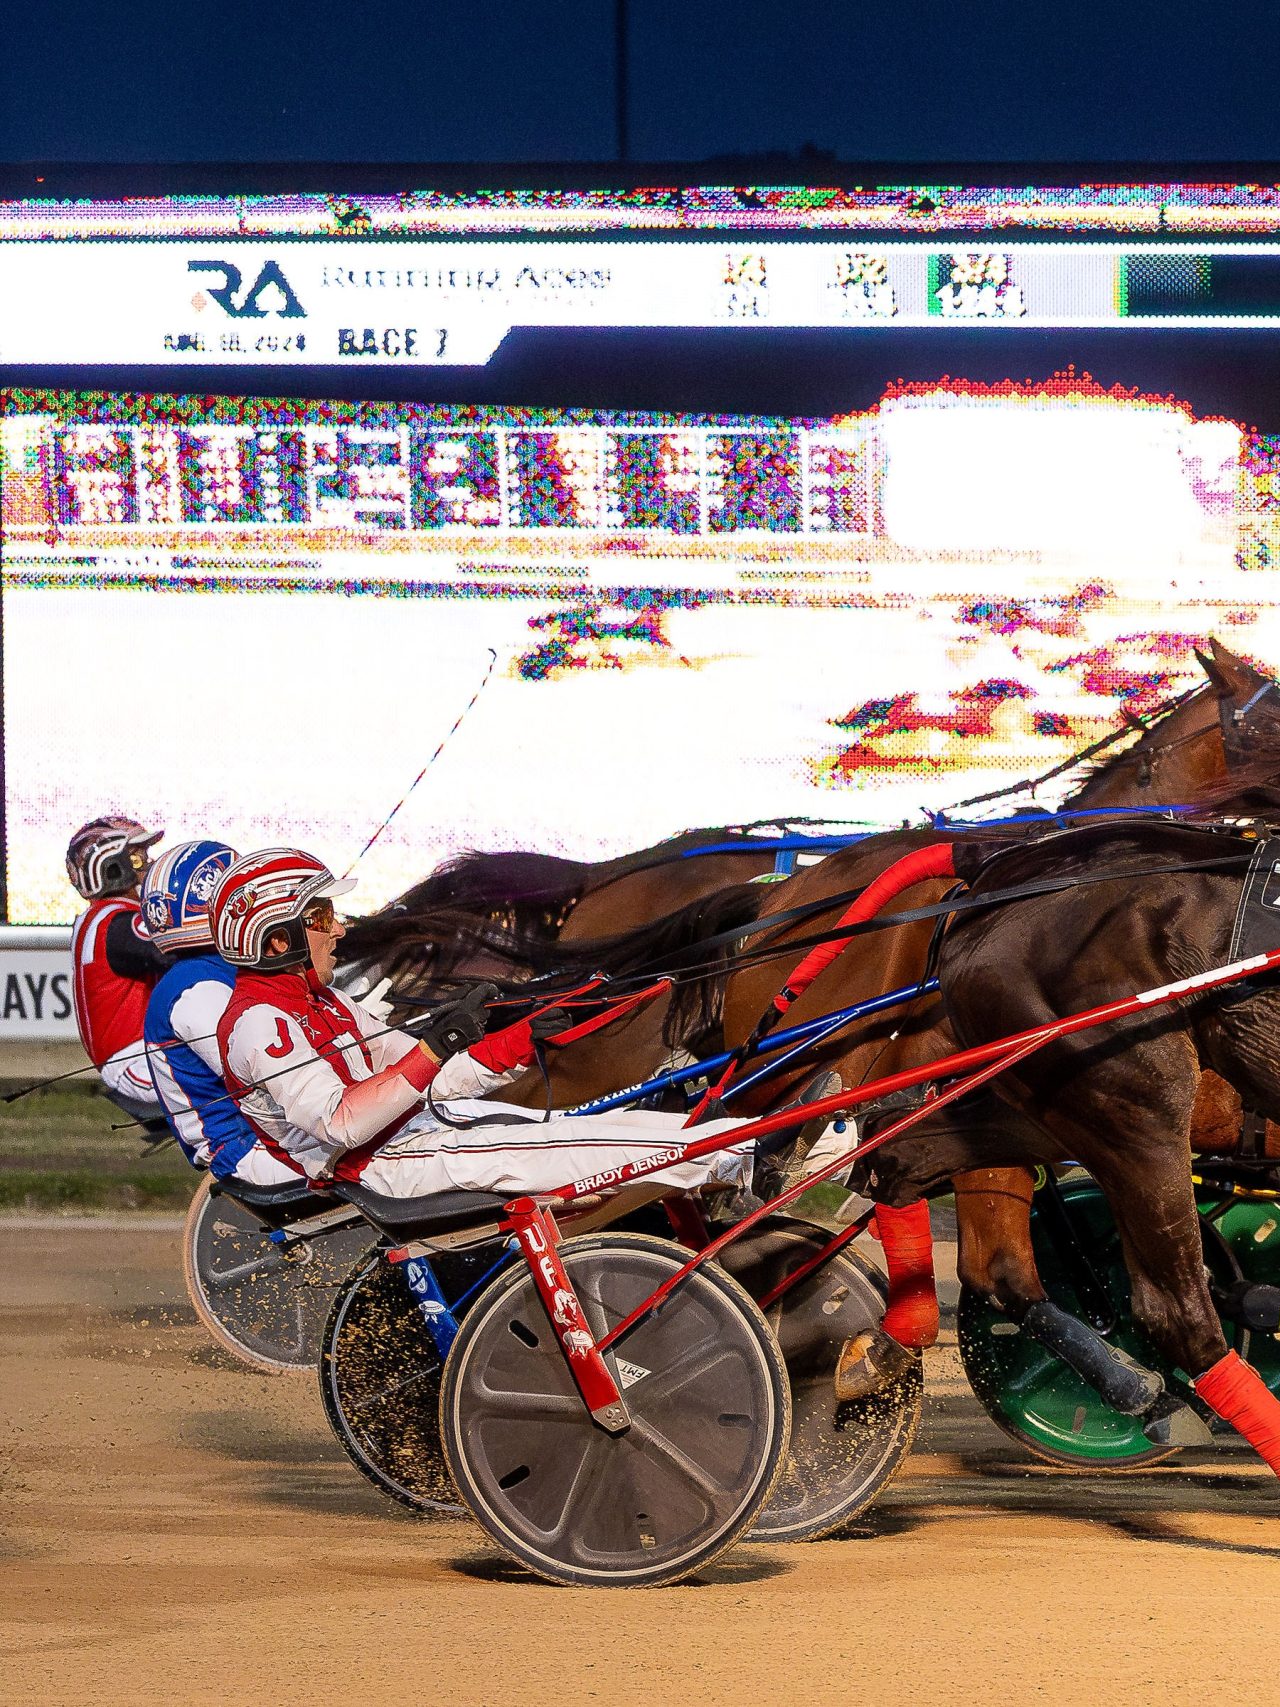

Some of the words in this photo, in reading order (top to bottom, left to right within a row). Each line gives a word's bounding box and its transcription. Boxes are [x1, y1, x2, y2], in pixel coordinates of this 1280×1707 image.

[338, 328, 419, 356] RACE
[264, 1017, 294, 1059] J
[573, 1167, 625, 1195] BRADY
[629, 1144, 688, 1175] JENSON
[619, 1364, 646, 1379] FMT
